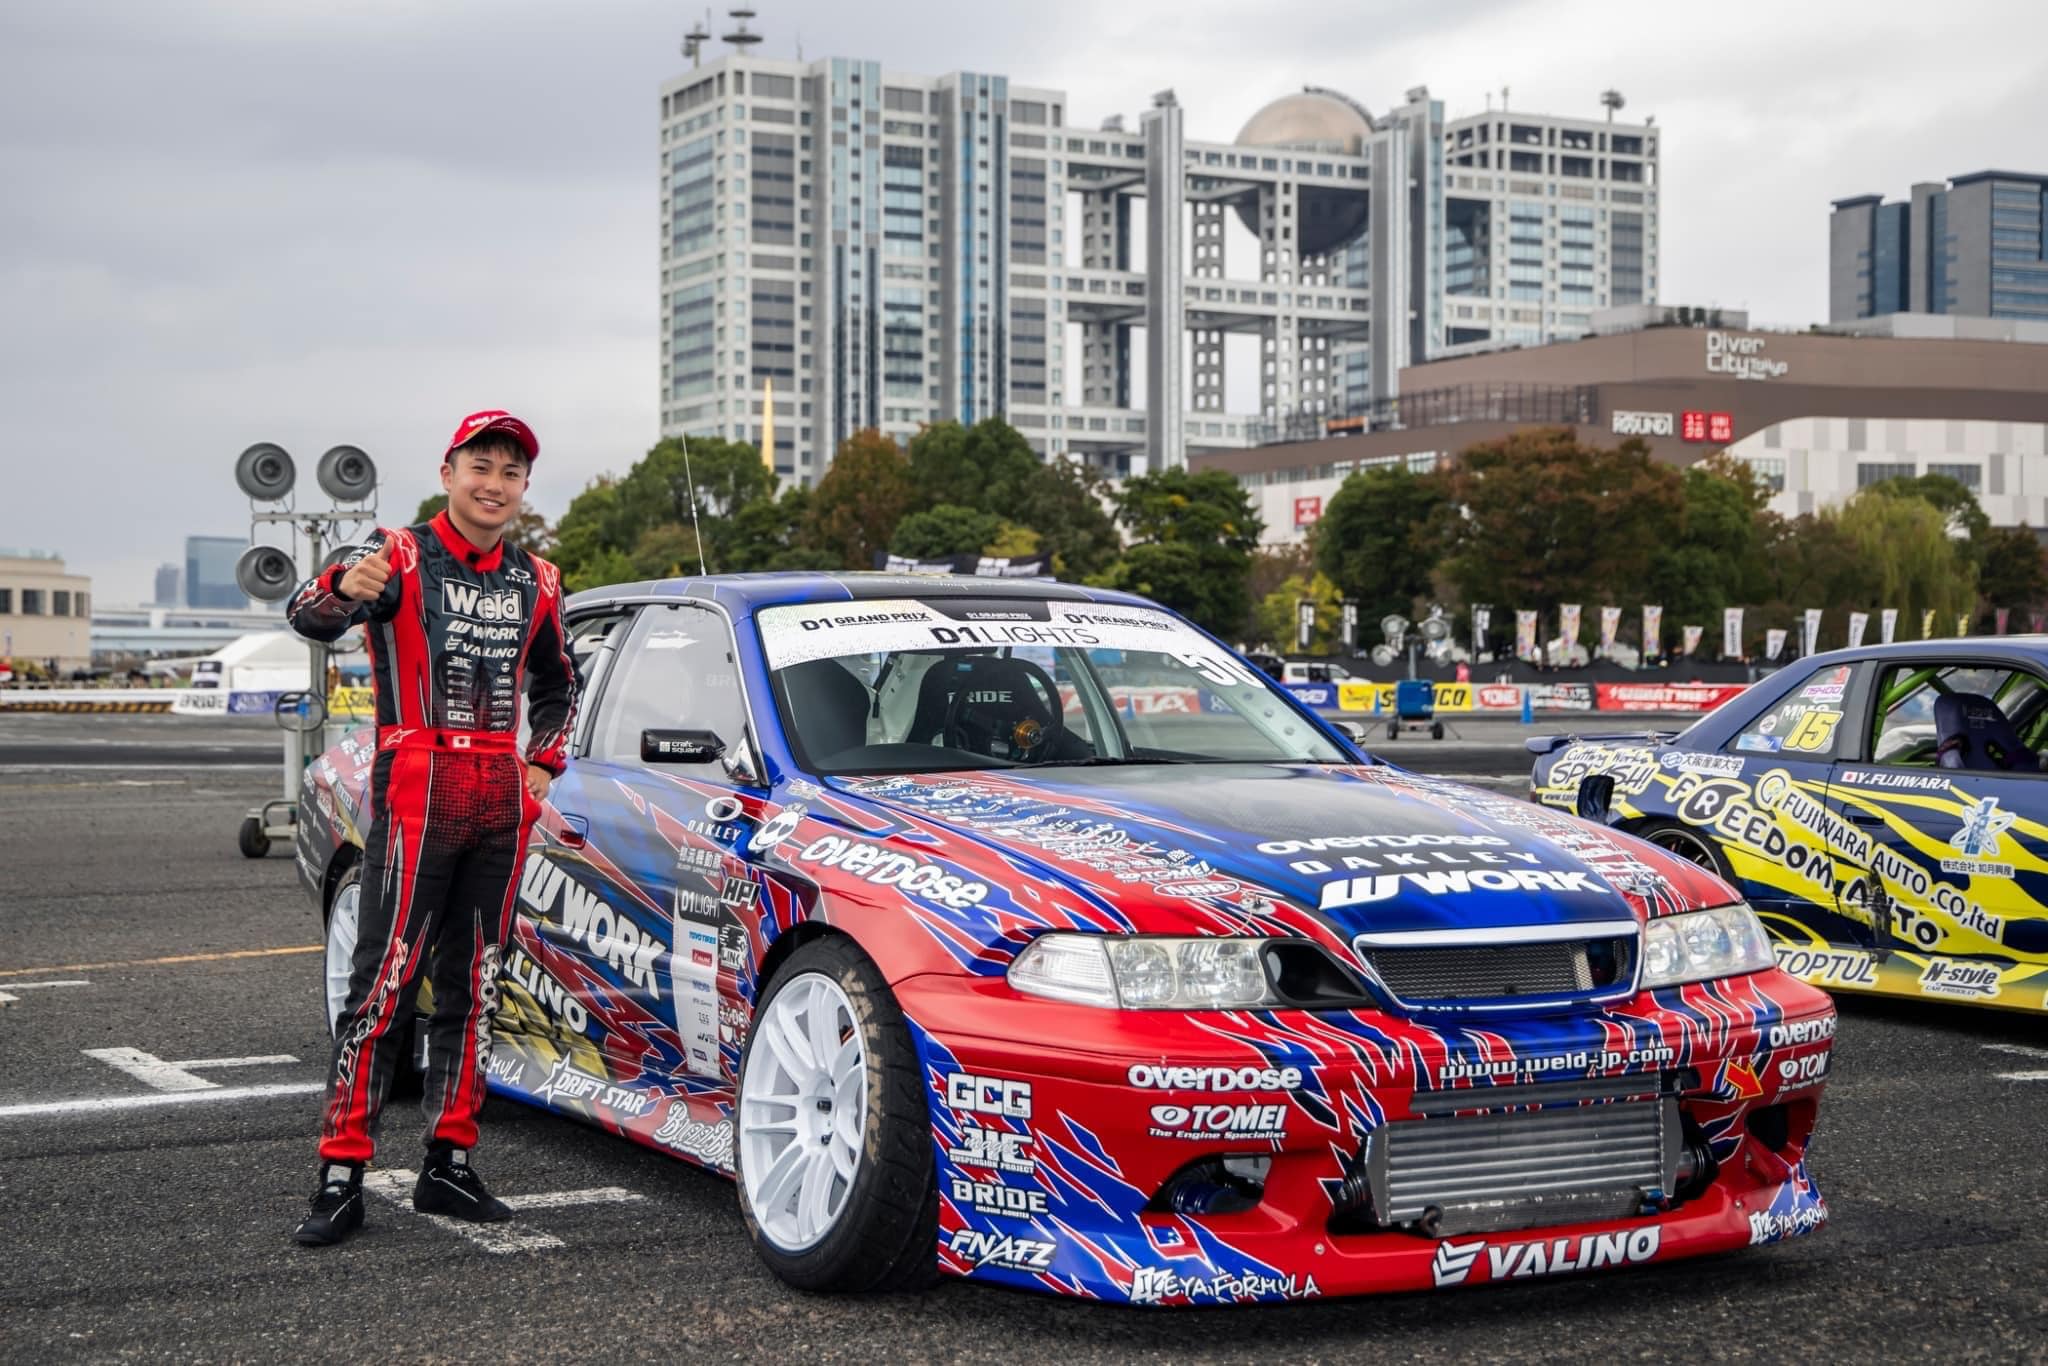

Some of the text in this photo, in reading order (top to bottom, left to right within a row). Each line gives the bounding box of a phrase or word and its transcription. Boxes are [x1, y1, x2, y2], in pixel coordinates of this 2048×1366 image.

[1707, 332, 1765, 353] Diver
[1707, 352, 1749, 379] City
[444, 582, 521, 621] Weld
[834, 614, 889, 625] GRAND
[891, 612, 930, 620] PRIX
[1095, 616, 1139, 626] GRAND
[472, 625, 520, 641] WORK
[462, 642, 519, 658] VALINO
[1782, 710, 1842, 751] 15
[1856, 773, 1951, 791] Y.FUJIWARA
[687, 820, 741, 841] OAKLEY
[1782, 792, 1868, 863] FUJIWARA
[1871, 849, 1928, 895] AUTO
[1289, 850, 1546, 874] OAKLEY
[1670, 777, 1833, 889] FREEDOM
[1846, 878, 1940, 946] ATO
[1405, 869, 1611, 895] WORK
[562, 876, 668, 1000] WORK
[1776, 949, 1873, 983] TOPTUL
[1923, 962, 1998, 985] N-style
[1439, 1045, 1674, 1081] www.weld-jp.com
[555, 1068, 650, 1116] DRIFT STAR
[947, 1073, 1032, 1119] GCG
[1191, 1105, 1288, 1130] TOMEI
[1149, 1128, 1287, 1140] The Engine Specialist
[951, 1179, 1049, 1214] BRIDE
[1488, 1225, 1661, 1281] VALINO
